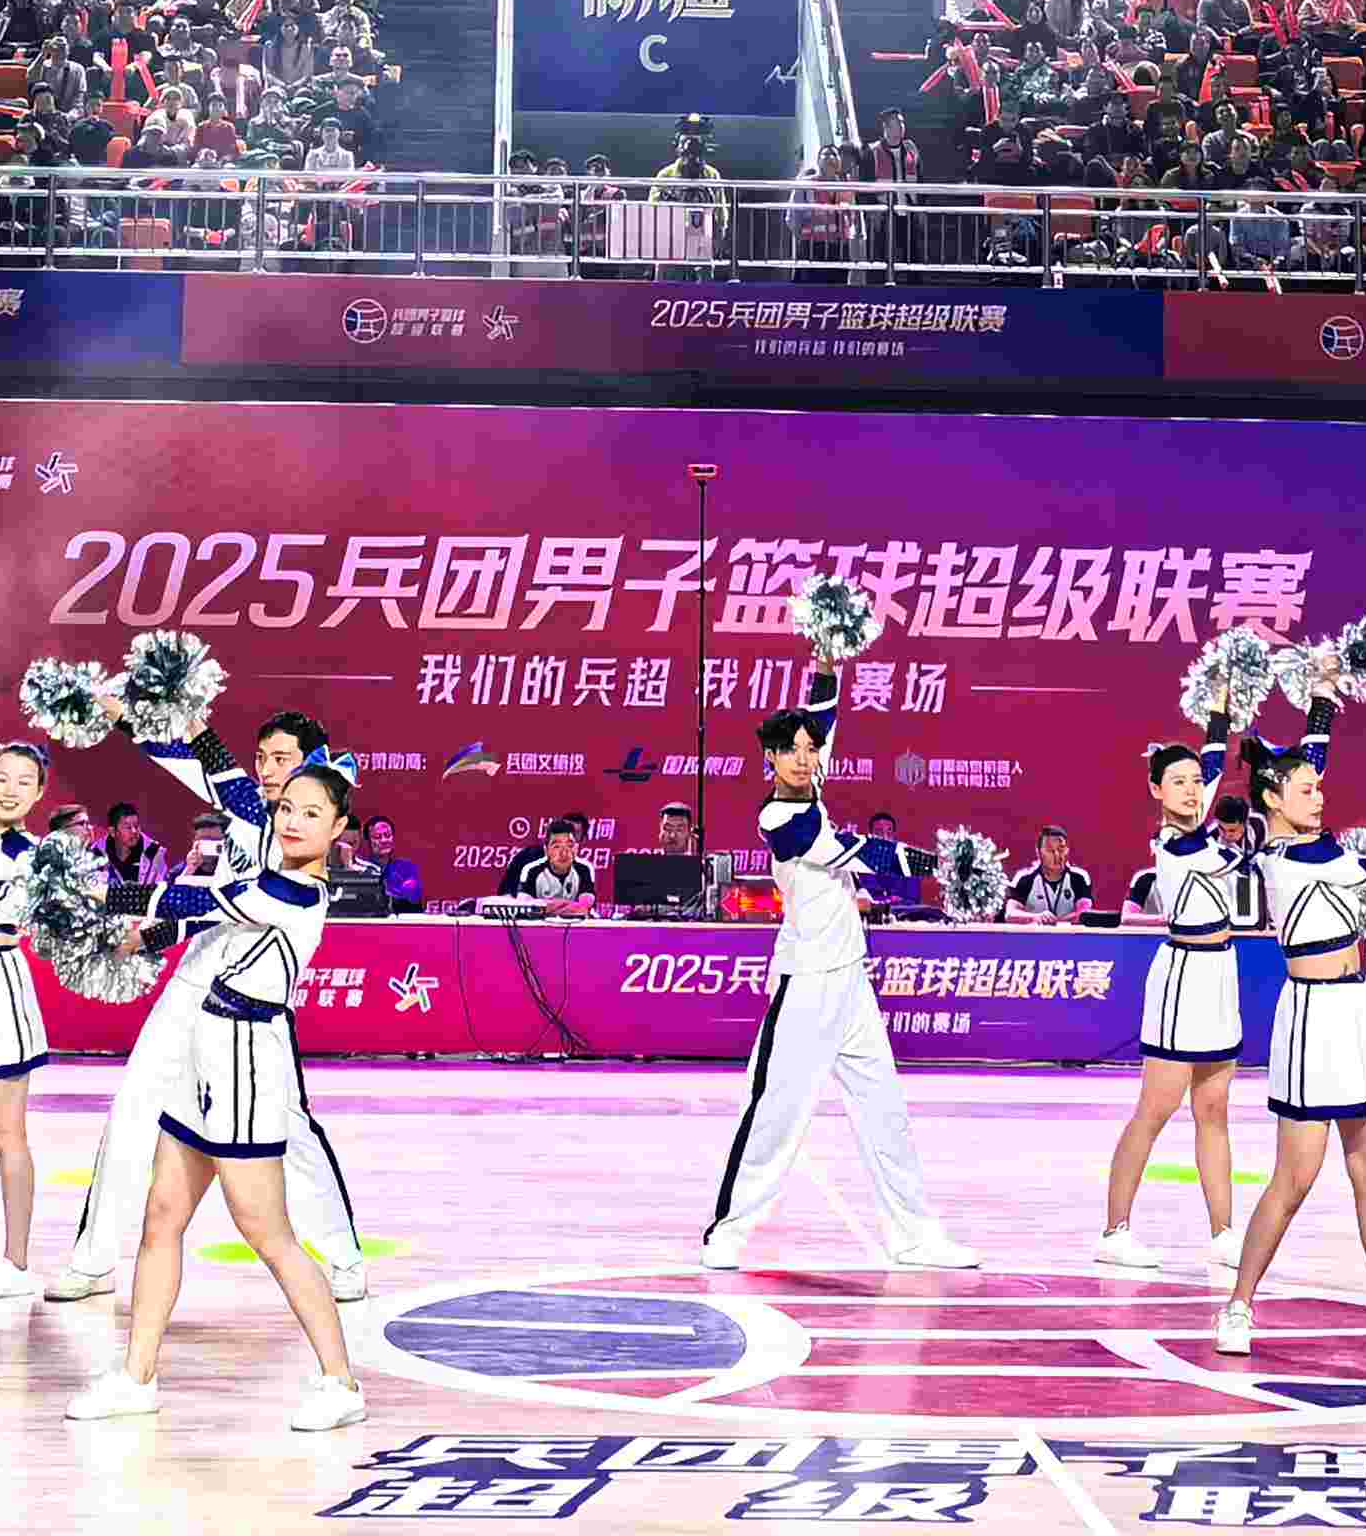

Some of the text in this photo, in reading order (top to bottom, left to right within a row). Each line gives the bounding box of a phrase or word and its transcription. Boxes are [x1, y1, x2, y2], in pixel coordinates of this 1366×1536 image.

[639, 34, 669, 72] C
[650, 299, 1008, 333] 2025兵团男子篮球超级联赛
[48, 530, 1314, 643] 2025兵团男子篮球超级联赛
[416, 655, 670, 708] 我们的兵超
